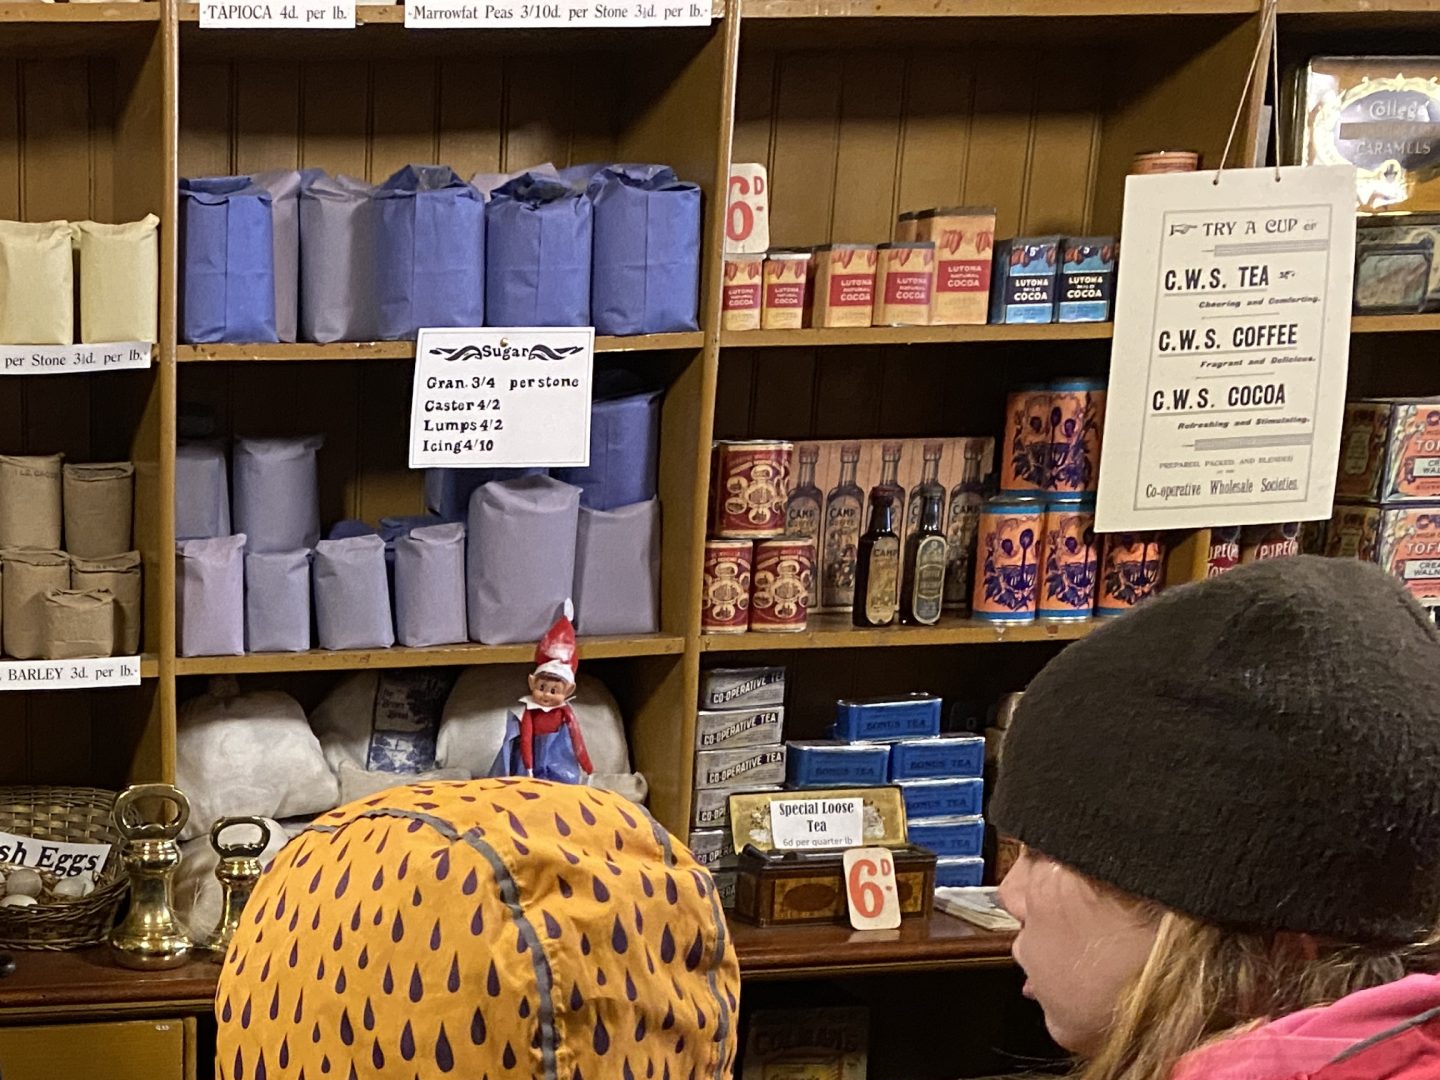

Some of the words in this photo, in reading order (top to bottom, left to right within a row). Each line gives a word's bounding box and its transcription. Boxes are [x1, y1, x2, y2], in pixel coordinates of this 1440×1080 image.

[207, 5, 272, 19] TAPIOCA
[306, 9, 326, 23] per
[413, 5, 478, 19] Marrowfat
[485, 5, 514, 19] Peas
[568, 7, 588, 21] per
[594, 4, 628, 19] Stone
[664, 7, 683, 21] per
[1203, 221, 1237, 236] TRY
[1245, 220, 1257, 234] A
[1265, 218, 1298, 232] CUP
[947, 279, 980, 288] COCOA
[1015, 278, 1049, 287] LUTONA
[1068, 275, 1103, 284] LUTONA
[1165, 267, 1227, 291] C.W.S.
[1238, 265, 1269, 288] TEA
[840, 292, 871, 301] COCOA
[896, 290, 925, 300] COCOA
[1014, 292, 1048, 301] COCOA
[1067, 289, 1102, 299] COCOA
[1247, 298, 1264, 306] and
[1159, 328, 1221, 352] C.W.S.
[1232, 324, 1299, 348] COFFEE
[4, 354, 25, 369] per
[31, 351, 67, 366] Stone
[104, 353, 123, 366] per
[482, 345, 529, 361] Sugar
[1200, 359, 1243, 369] Fragrant
[1248, 357, 1265, 365] and
[426, 376, 468, 389] Gran.
[471, 376, 496, 389] 3/4
[509, 378, 535, 391] per
[538, 376, 579, 388] stone
[1152, 388, 1216, 411] C.W.S.
[1228, 383, 1286, 407] COCOA
[477, 399, 501, 411] 4/2
[424, 419, 477, 433] Lumps
[1234, 418, 1251, 427] and
[422, 439, 463, 454] Icing
[1146, 482, 1201, 501] Co-operative
[1210, 478, 1254, 496] Wholesale
[788, 506, 816, 520] CAMP
[829, 507, 856, 519] CAMP
[8, 667, 63, 681] BARLEY
[96, 668, 114, 681] per
[713, 677, 767, 704] CO-OPERATIVE
[703, 718, 756, 745] CO-OPERATIVE
[759, 712, 776, 726] TEA
[907, 718, 928, 729] TEA
[709, 758, 763, 784] CO-OPERATIVE
[766, 751, 782, 764] TEA
[951, 759, 972, 769] TEA
[779, 802, 819, 815] Special
[822, 801, 854, 813] Loose
[807, 820, 827, 833] Tea
[783, 837, 795, 847] 6d
[796, 839, 810, 848] per
[812, 837, 843, 847] quarter
[35, 846, 100, 877] Eggs
